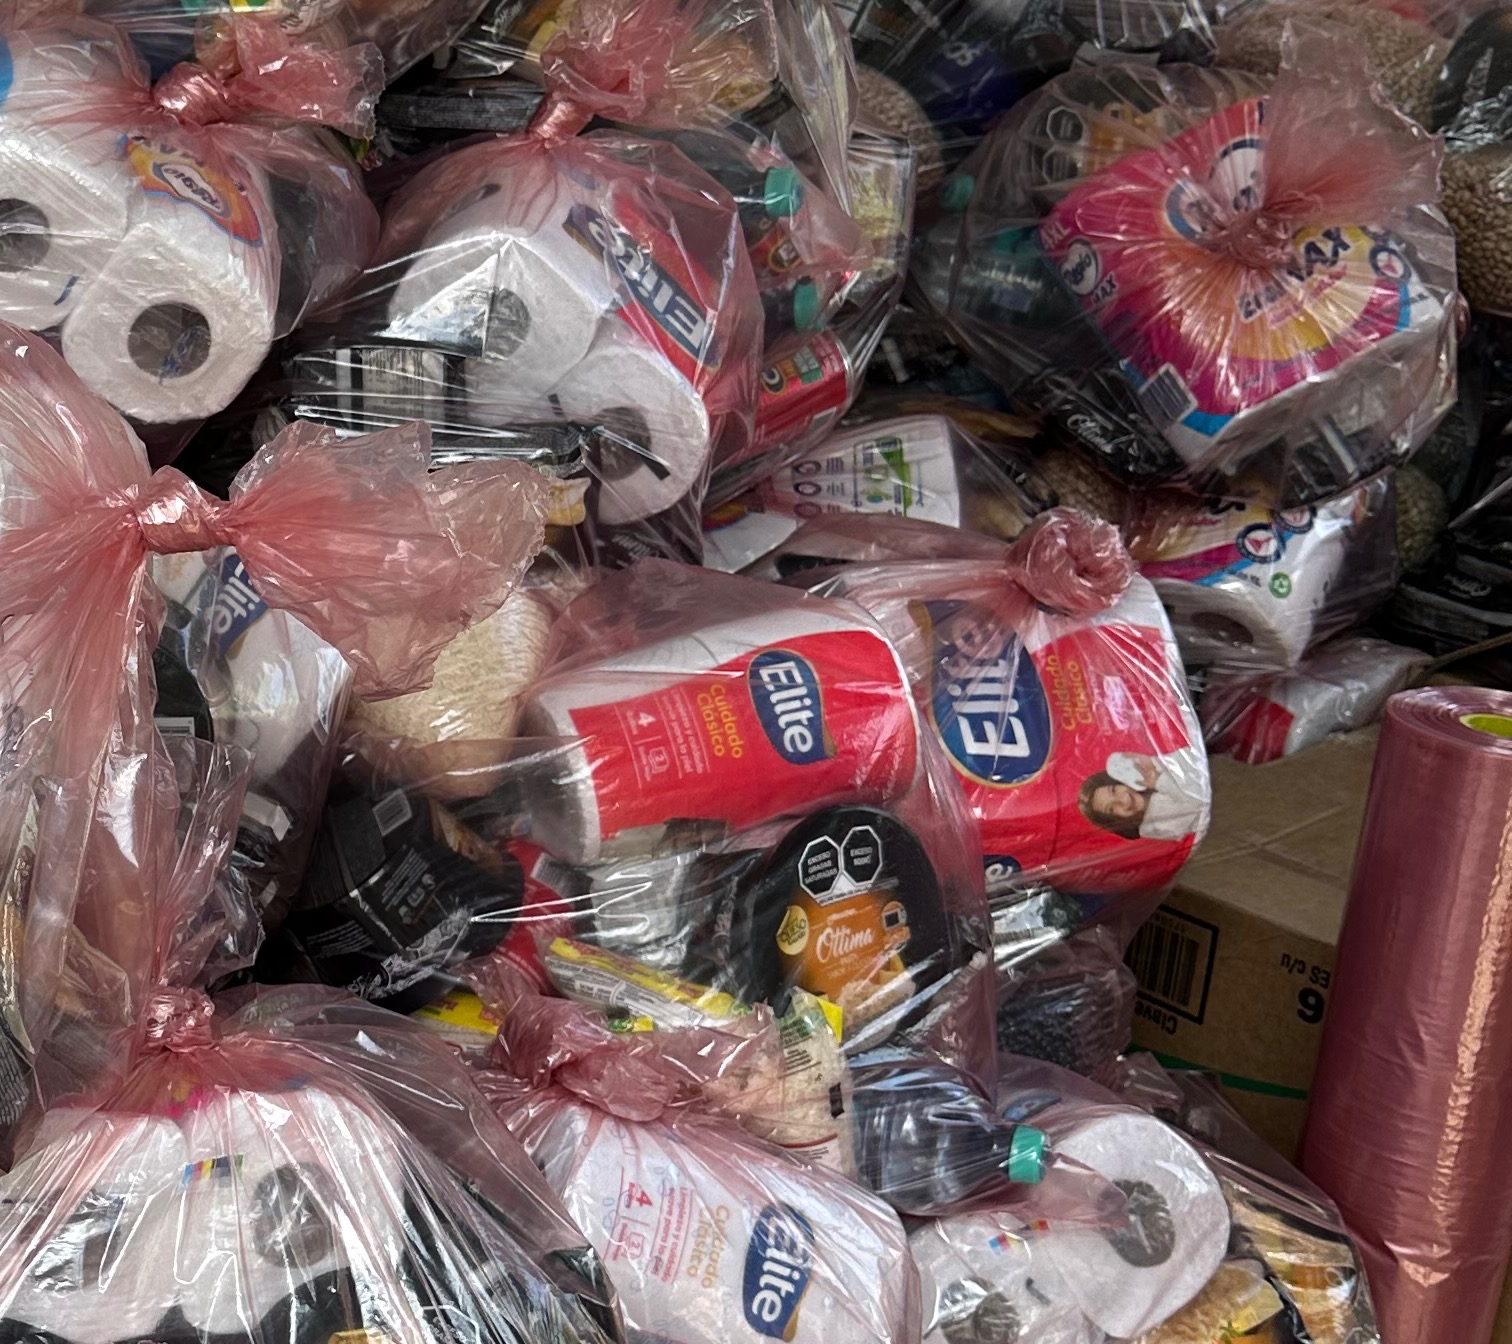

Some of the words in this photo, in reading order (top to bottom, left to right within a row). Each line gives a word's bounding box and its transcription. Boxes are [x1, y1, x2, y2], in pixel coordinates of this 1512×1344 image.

[589, 216, 707, 349] Elite
[213, 561, 261, 635] lite
[637, 713, 656, 728] 4
[710, 683, 744, 759] Cuidado
[759, 660, 814, 755] Elite
[942, 616, 1031, 757] Elite
[1045, 655, 1076, 732] Cuidado
[697, 692, 725, 757] Clásico
[816, 924, 874, 964] Ottima
[1280, 952, 1306, 975] c/u
[1297, 987, 1324, 1024] 6
[635, 1189, 653, 1207] 4
